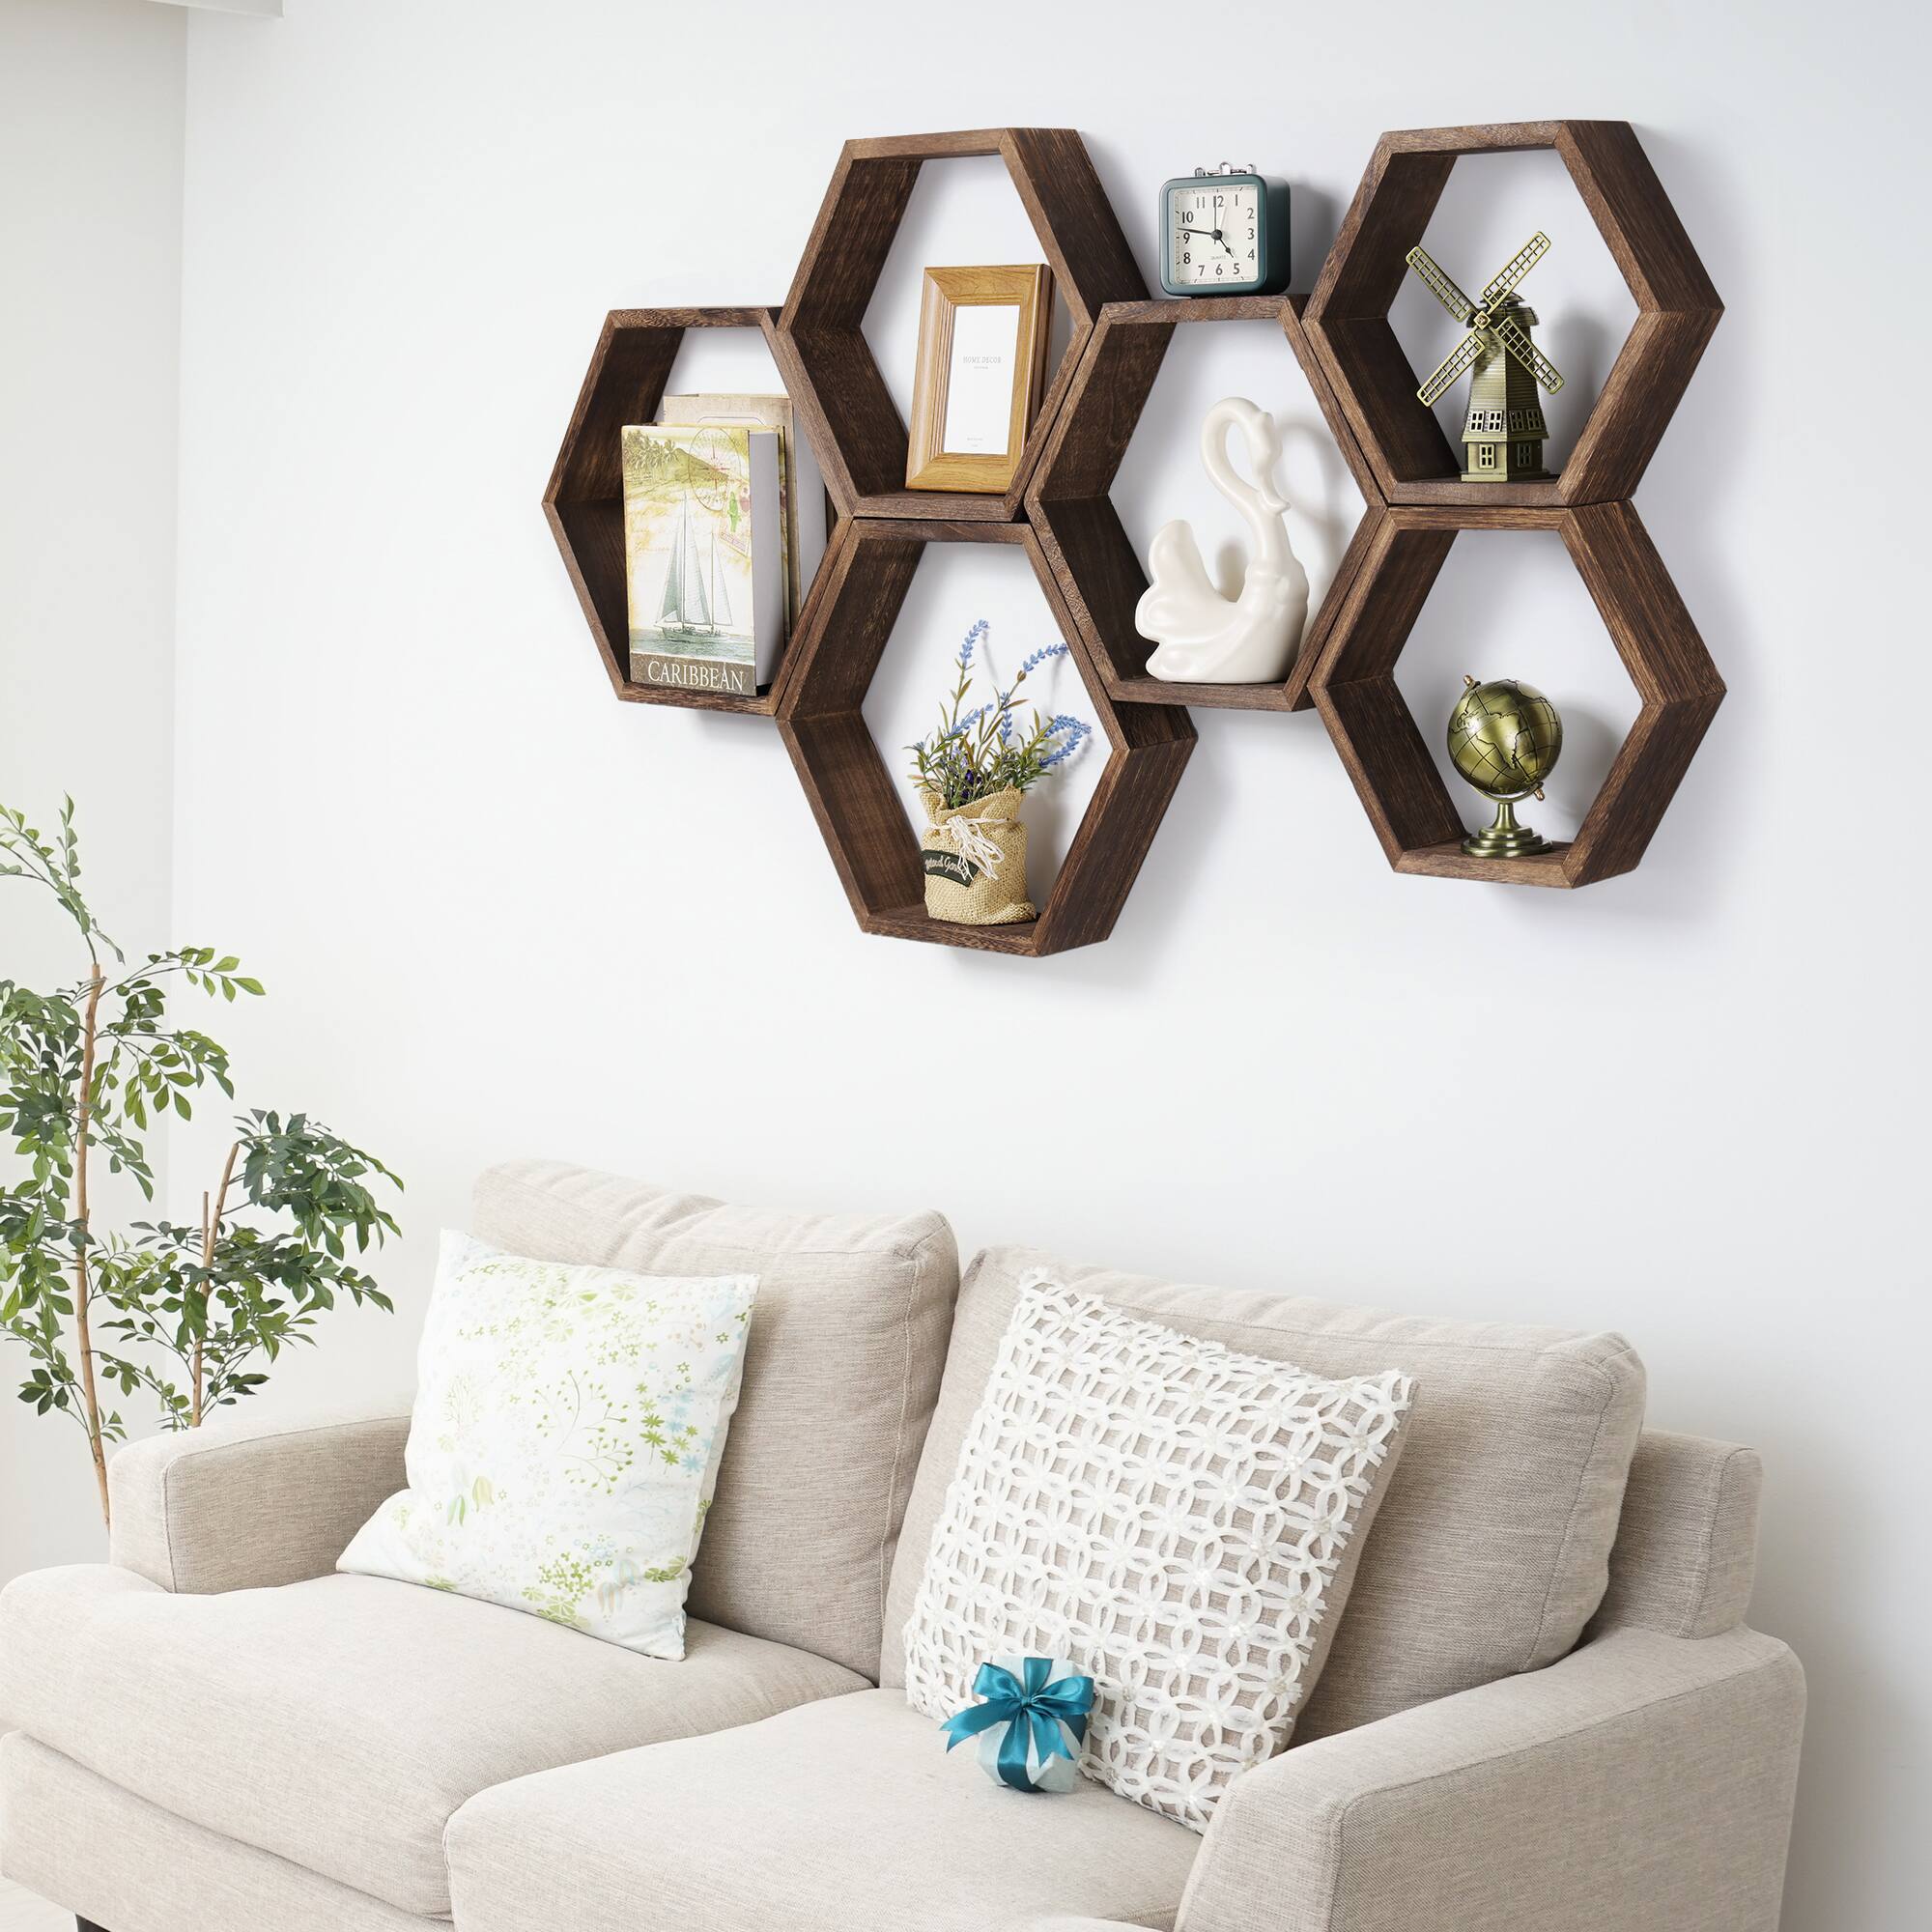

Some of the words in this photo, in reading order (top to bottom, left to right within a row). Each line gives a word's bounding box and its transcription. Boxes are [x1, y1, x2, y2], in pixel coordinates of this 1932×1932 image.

[1196, 196, 1206, 209] 11
[1212, 195, 1224, 208] 12
[1235, 193, 1238, 207] 1
[1181, 211, 1194, 223] 10
[1247, 207, 1255, 219] 2
[1183, 232, 1190, 244] 9
[1247, 227, 1255, 240] 3
[1183, 252, 1191, 265] 8
[1247, 248, 1255, 261] 4
[1198, 265, 1205, 276] 7
[1215, 264, 1223, 275] 6
[1233, 263, 1240, 275] 5
[962, 355, 980, 364] HOME
[981, 355, 1002, 364] DECOR
[647, 661, 744, 692] CARIBBEAN
